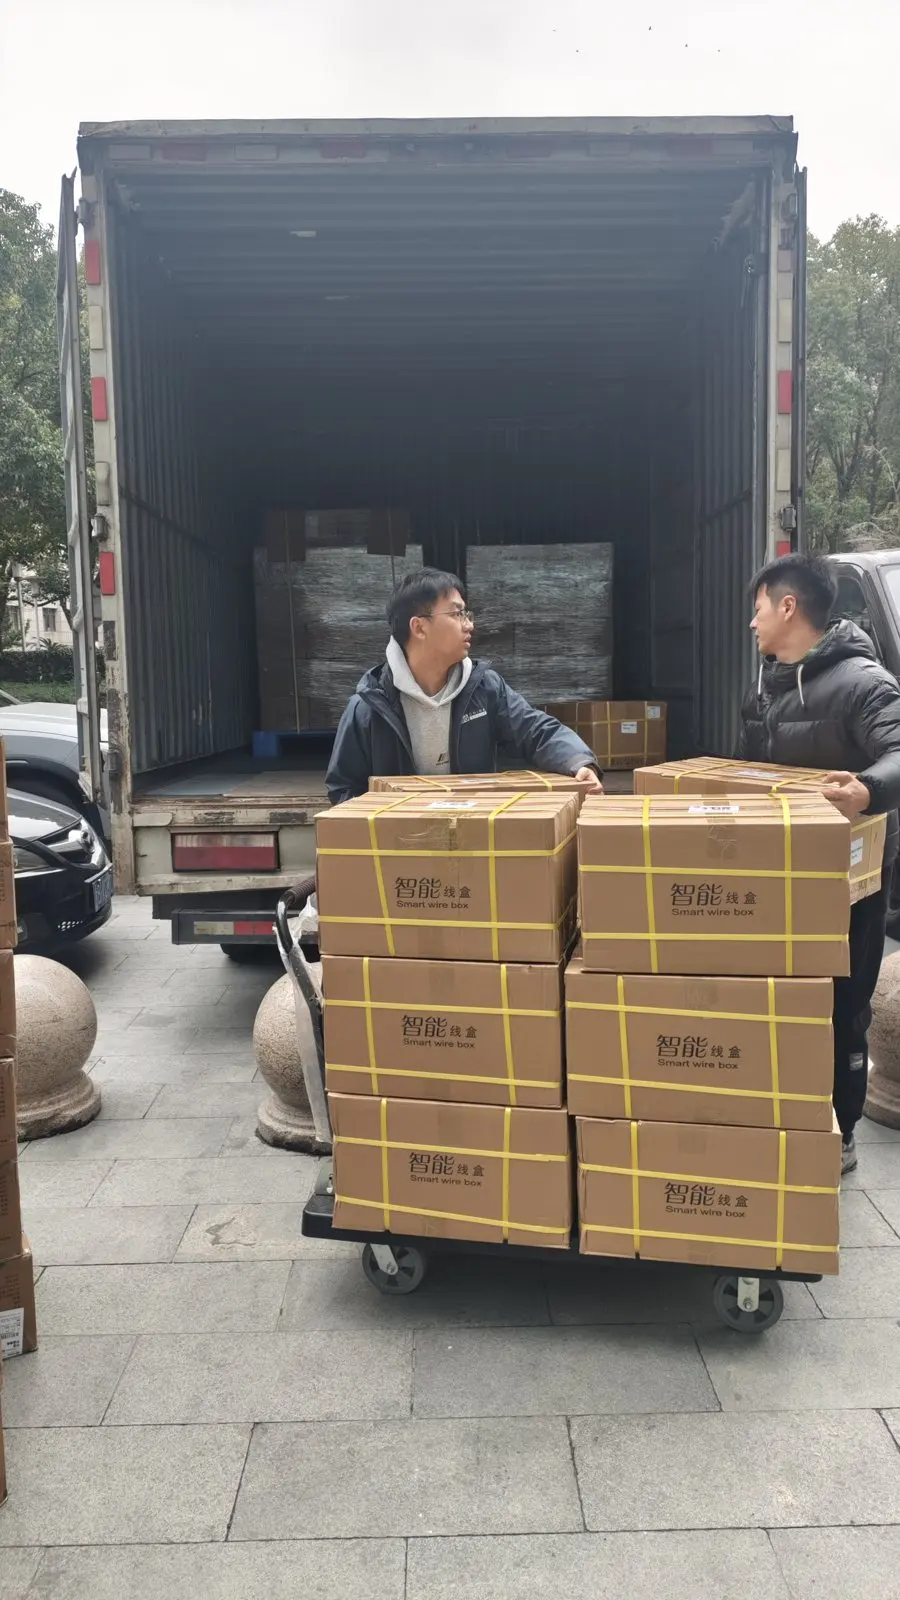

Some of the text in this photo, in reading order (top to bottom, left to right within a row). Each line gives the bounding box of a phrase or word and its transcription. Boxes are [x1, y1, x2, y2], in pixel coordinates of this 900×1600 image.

[394, 876, 471, 899] 智能线盒
[670, 882, 757, 906] 智能线盒
[427, 901, 448, 909] wire
[450, 901, 469, 909] box
[671, 908, 754, 916] Smart wire box
[401, 1014, 477, 1038] 智能线盒
[404, 1038, 475, 1049] Smart wire box
[656, 1034, 741, 1059] 智能线盒
[657, 1058, 738, 1069] Smart wire box
[408, 1151, 485, 1177] 智能线盒
[410, 1174, 439, 1184] Smart
[464, 1178, 482, 1187] box
[664, 1181, 749, 1208] 智能线盒
[665, 1205, 745, 1218] Smart wire box
